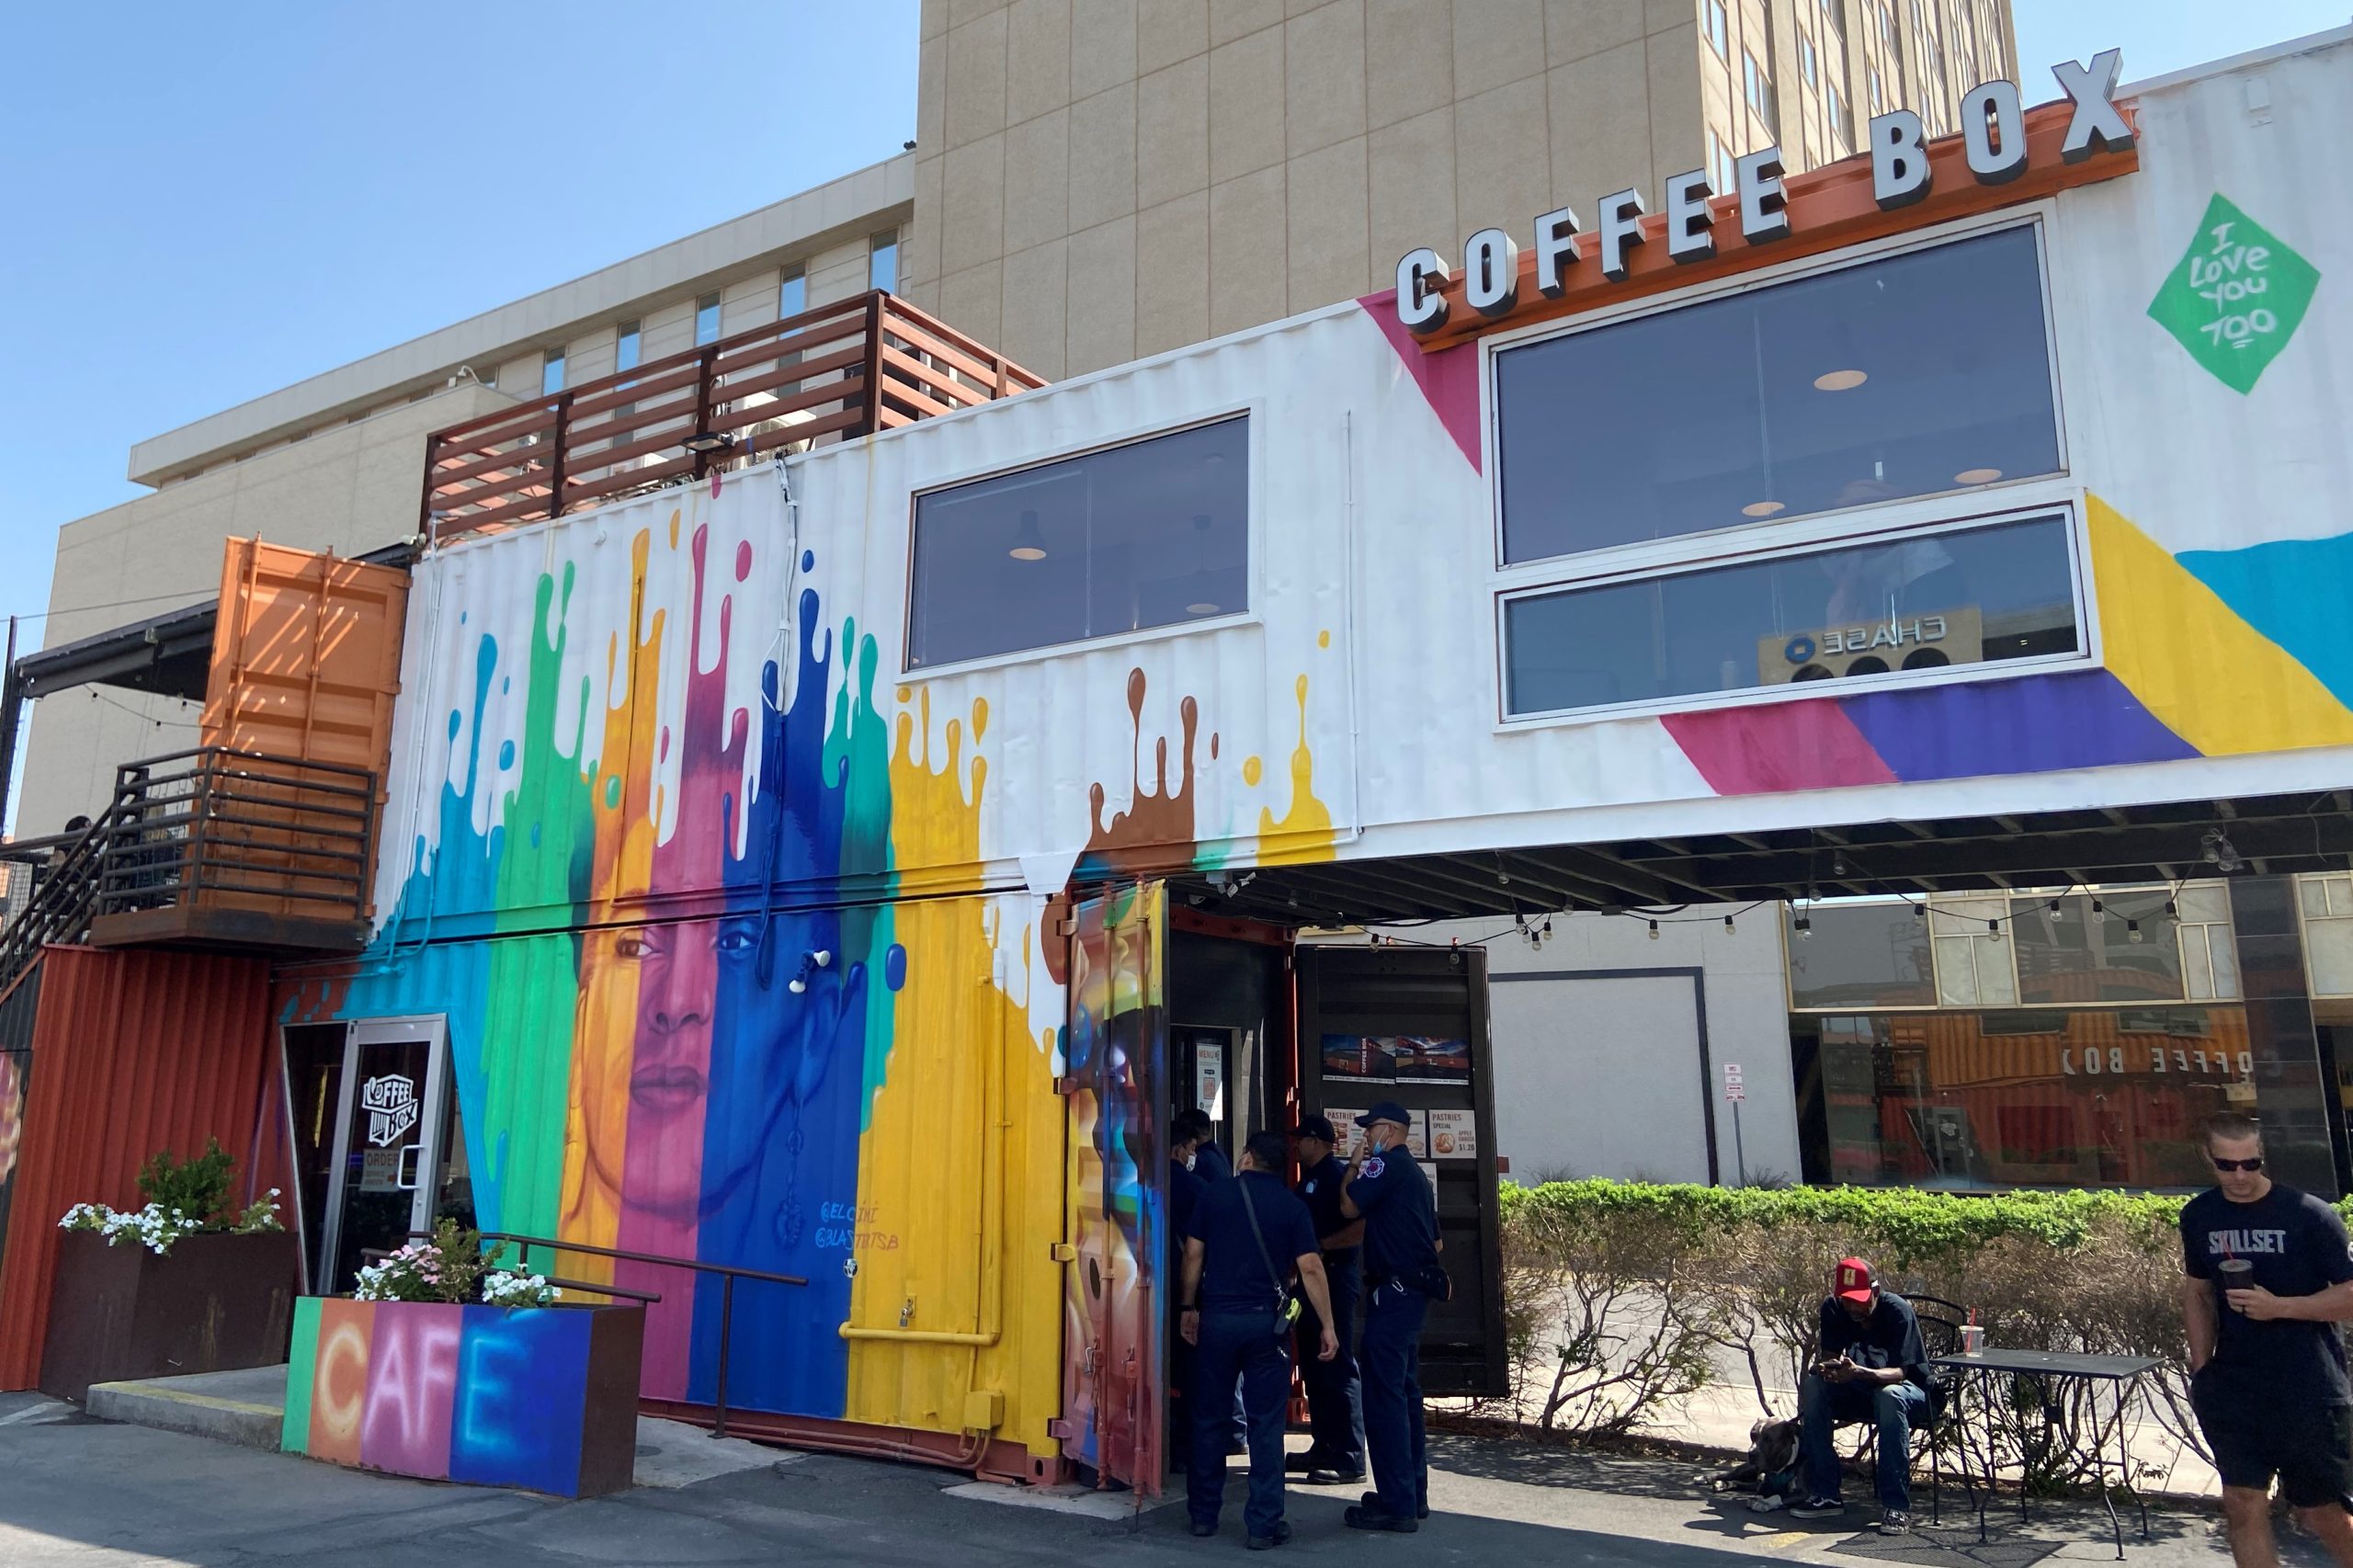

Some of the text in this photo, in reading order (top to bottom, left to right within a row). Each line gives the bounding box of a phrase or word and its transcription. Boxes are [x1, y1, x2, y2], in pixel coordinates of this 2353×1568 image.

[1395, 47, 2133, 334] COFFEE BOX
[2211, 222, 2236, 255] I
[1198, 1050, 1213, 1059] MENU
[367, 1076, 411, 1107] COFFEE
[388, 1102, 415, 1139] BOX
[1327, 1111, 1357, 1120] PASTRIES
[1432, 1113, 1462, 1121] PASTRIES
[2208, 1229, 2286, 1255] SKILLSET
